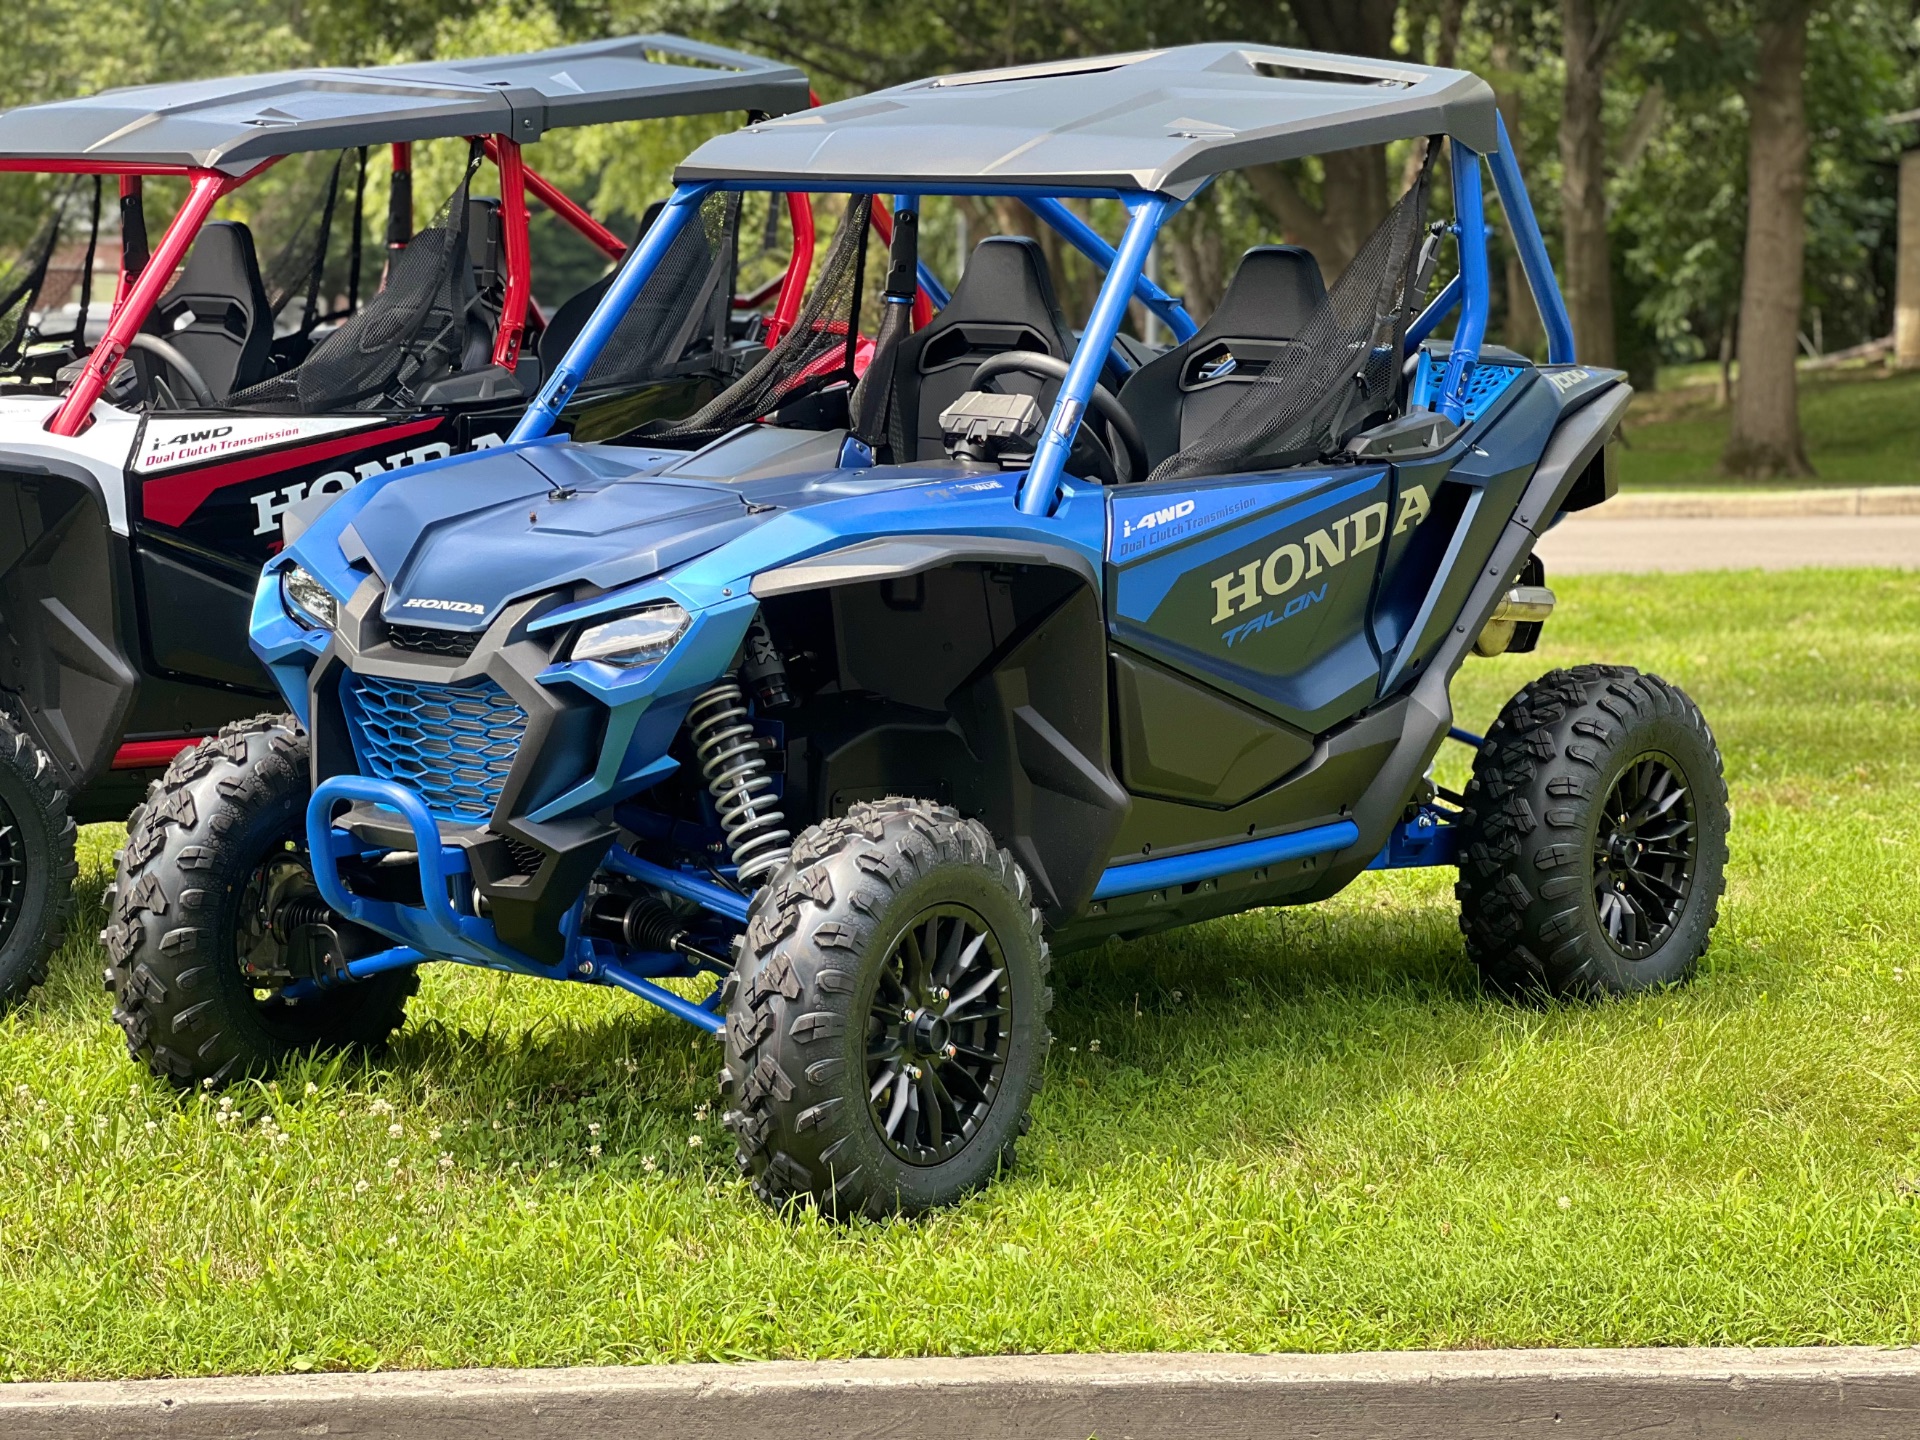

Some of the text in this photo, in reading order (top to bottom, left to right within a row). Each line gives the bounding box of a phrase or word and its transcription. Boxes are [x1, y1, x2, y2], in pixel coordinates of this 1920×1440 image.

[146, 427, 299, 466] Dual Clutch Transmission
[152, 426, 233, 451] i-4WD
[1120, 497, 1257, 556] Dual Clutch Transmission
[1123, 499, 1196, 538] i-4WD
[1211, 484, 1431, 625] HONDA
[403, 598, 485, 615] HONDA
[1221, 582, 1328, 648] TALON
